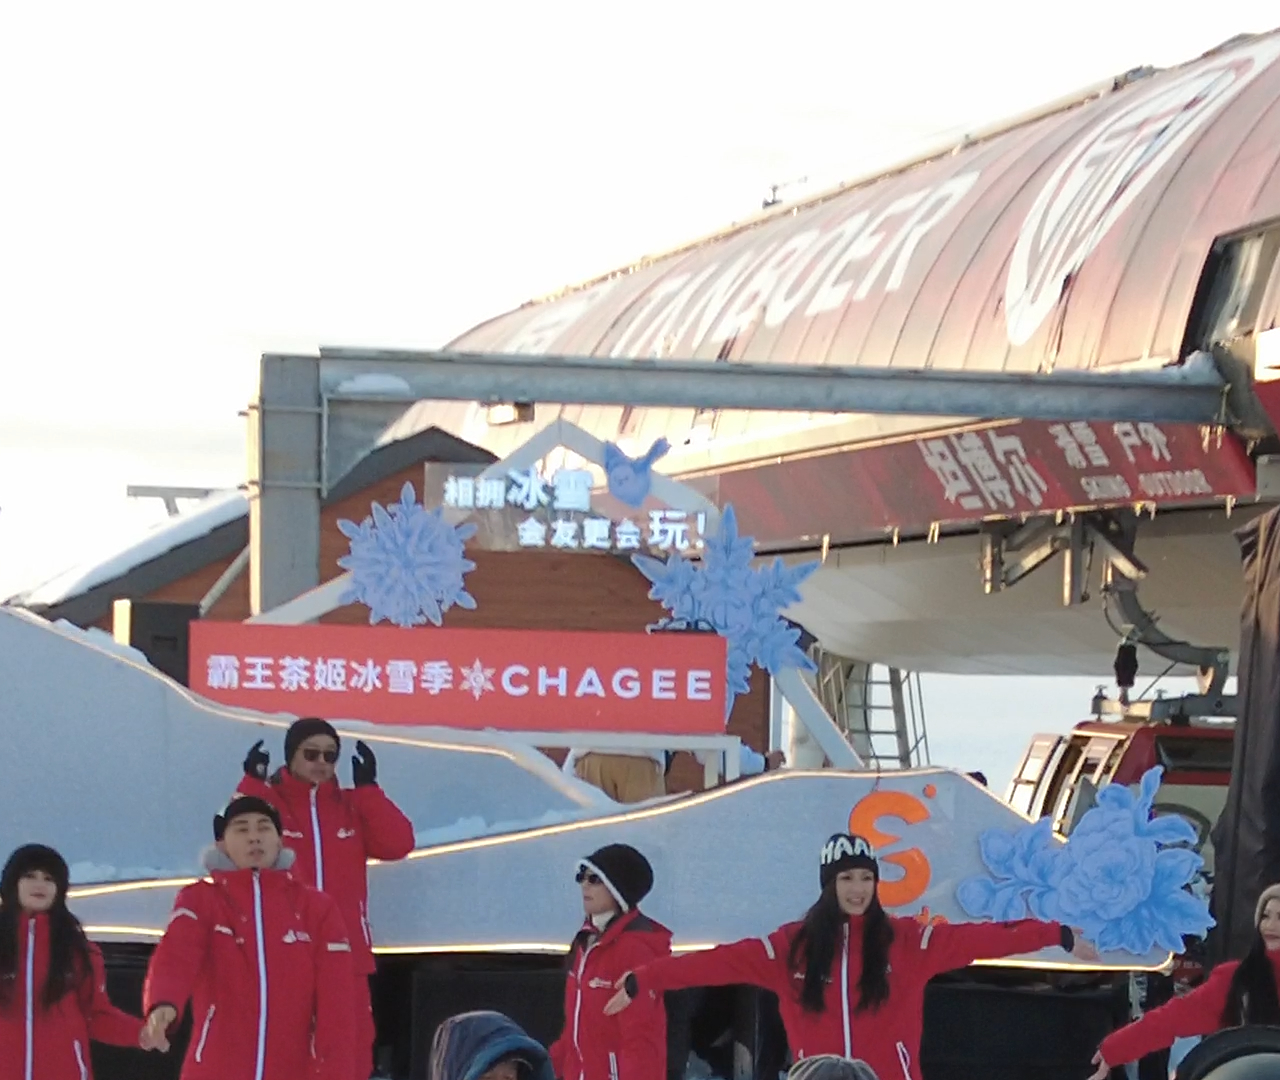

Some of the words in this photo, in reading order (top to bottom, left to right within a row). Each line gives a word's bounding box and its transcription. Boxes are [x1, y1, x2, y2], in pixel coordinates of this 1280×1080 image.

[444, 466, 593, 512] 相拥冰雪
[206, 654, 454, 694] 霸王茶姬冰雪季
[501, 664, 712, 700] CHAGEE
